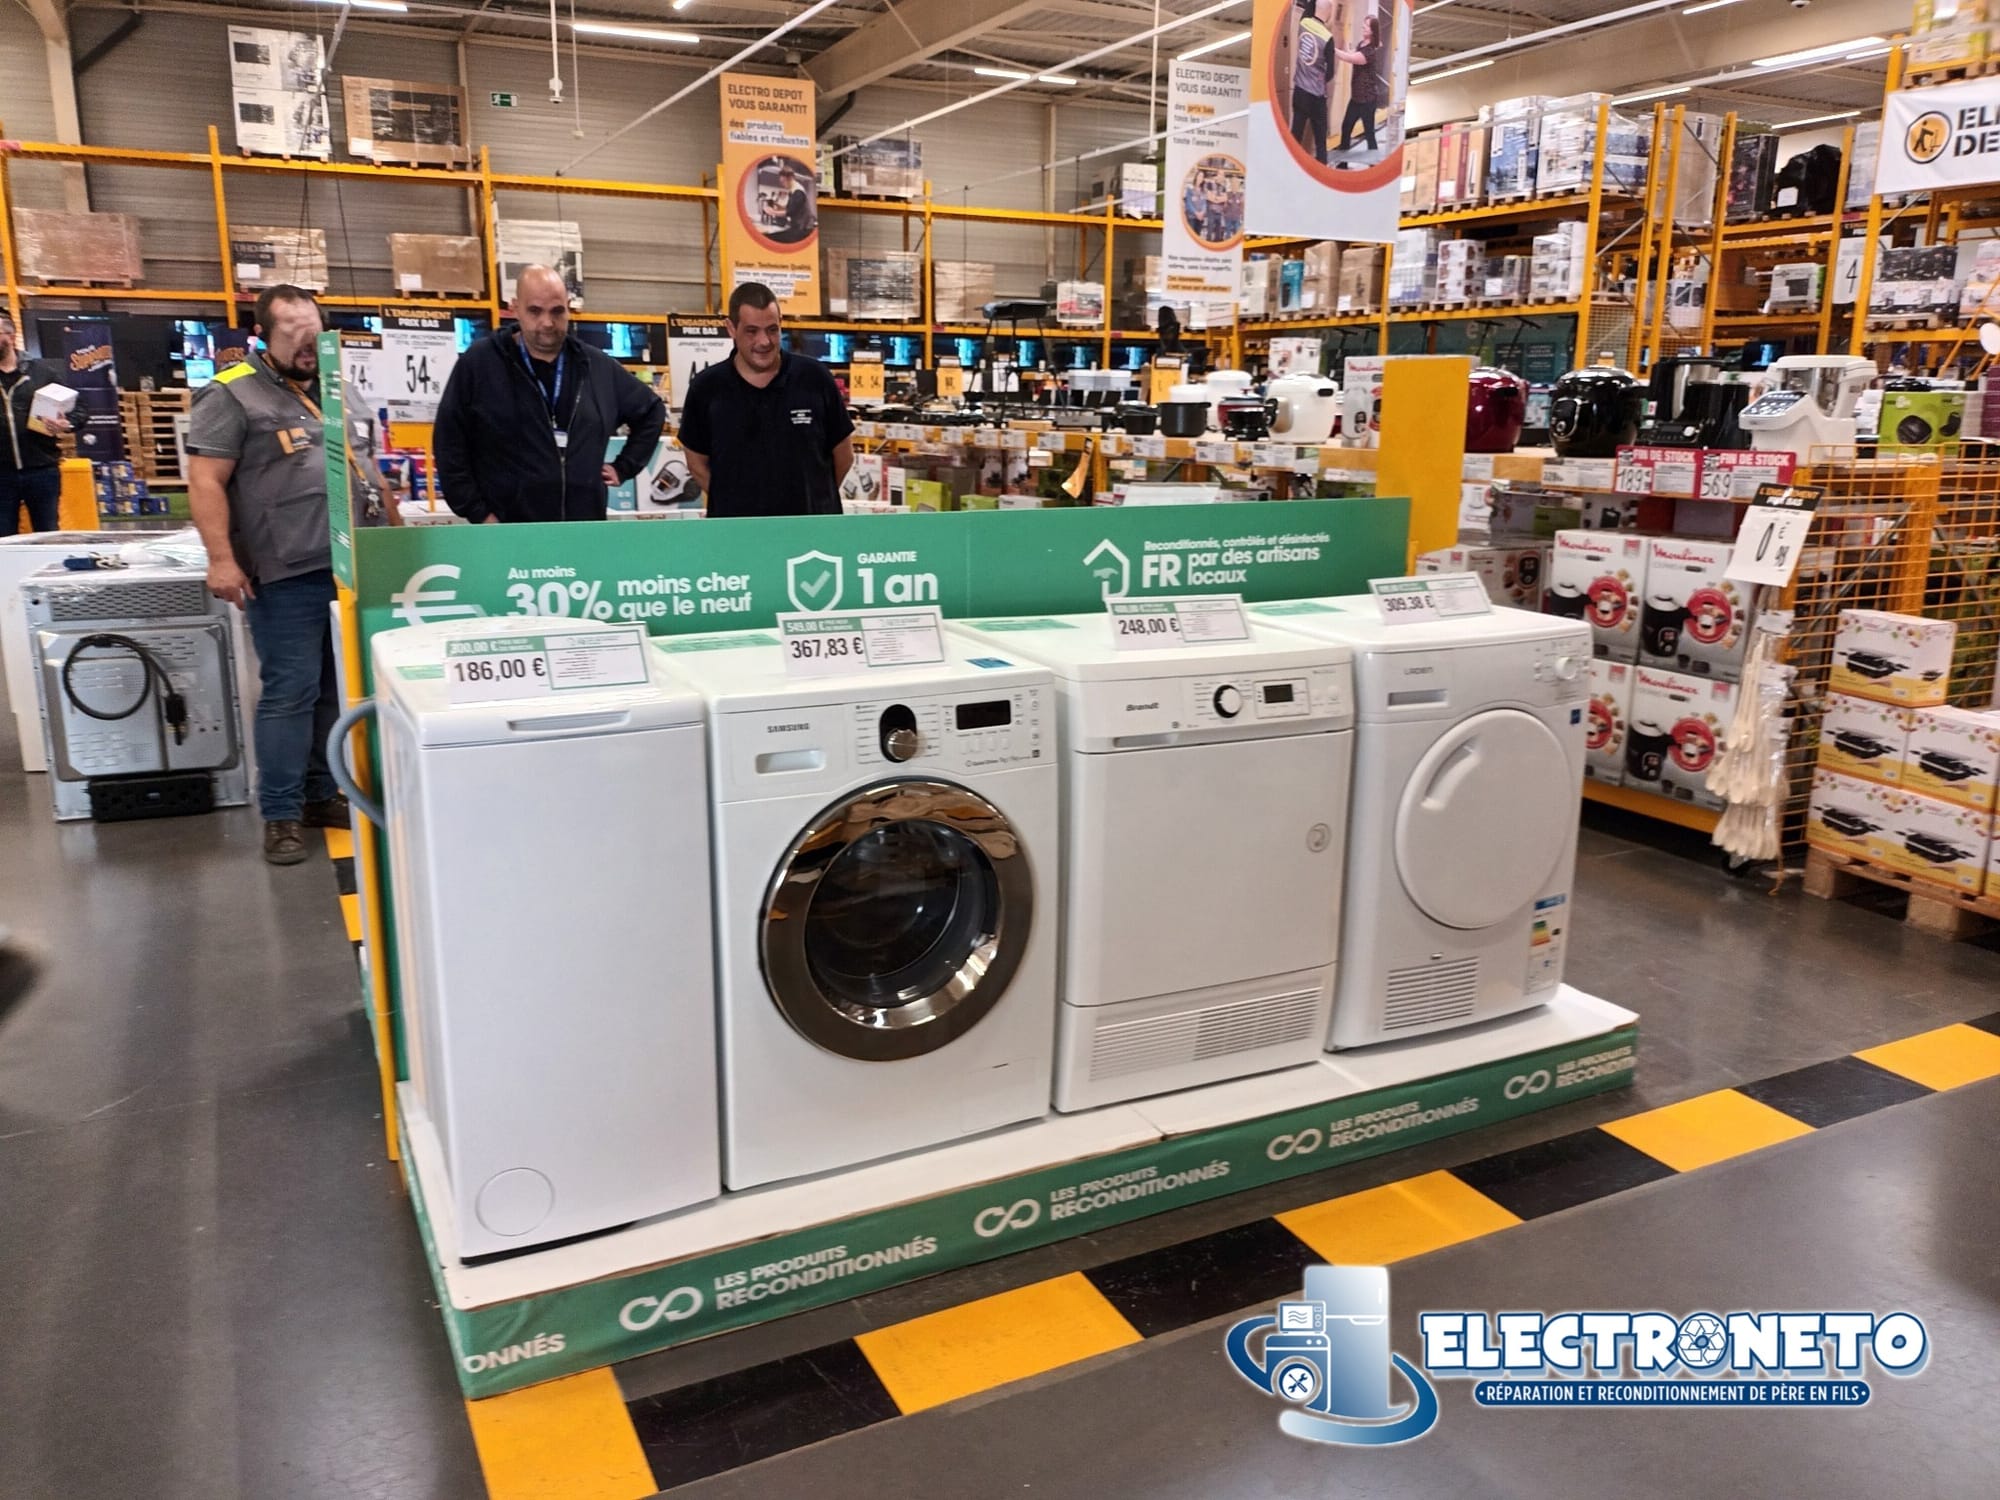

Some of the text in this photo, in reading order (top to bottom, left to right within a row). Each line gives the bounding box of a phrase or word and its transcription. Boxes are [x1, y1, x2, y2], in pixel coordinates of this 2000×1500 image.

[1175, 67, 1240, 85] ELECTRO DEPOT
[728, 83, 803, 100] ELECTRO DEPOT
[1175, 82, 1243, 98] VOUS GARANTIT
[728, 98, 808, 114] VOUS GARANTIT
[729, 119, 783, 132] des produits
[730, 131, 809, 145] fiables et robustes
[1954, 132, 2000, 156] DE
[384, 308, 452, 320] L'ENGAGEMENT
[398, 317, 440, 328] PRIX BAS
[682, 327, 719, 335] PRIX BAS
[406, 355, 431, 393] 54
[1633, 449, 1697, 463] FIN DE STOCK
[1720, 453, 1791, 466] FIN DE STOCK
[1144, 532, 1330, 551] Reconditionnés, contrôlés et désinfectés
[1557, 534, 1613, 553] Moulinex
[857, 551, 917, 564] GARANTIE
[1652, 544, 1715, 564] Moulinex
[508, 566, 577, 580] Au moins
[1142, 546, 1321, 588] FR par des artisans
[857, 567, 938, 604] 1 an
[1187, 569, 1247, 586] locaux
[506, 572, 751, 620] 30% moins cher
[622, 592, 753, 621] que le neuf
[1118, 618, 1167, 636] 248,00
[1170, 617, 1180, 633] €
[791, 637, 848, 659] 367,83
[852, 637, 864, 655] €
[454, 657, 526, 682] 186,00
[532, 657, 546, 677] €
[1126, 701, 1159, 712] Brandt
[767, 722, 810, 734] SAMSUNG
[1556, 1045, 1633, 1074] LES PRODUITS
[1329, 1096, 1480, 1148] RECONDITIONNÉS
[1330, 1101, 1420, 1133] LES PRODUITS
[1050, 1159, 1231, 1221] RECONDITIONNÉS
[1051, 1166, 1158, 1202] LES PRODUITS
[714, 1244, 848, 1290] LES PRODUITS
[715, 1236, 938, 1311] RECONDITIONNÉS
[463, 1333, 566, 1374] ONNÉS
